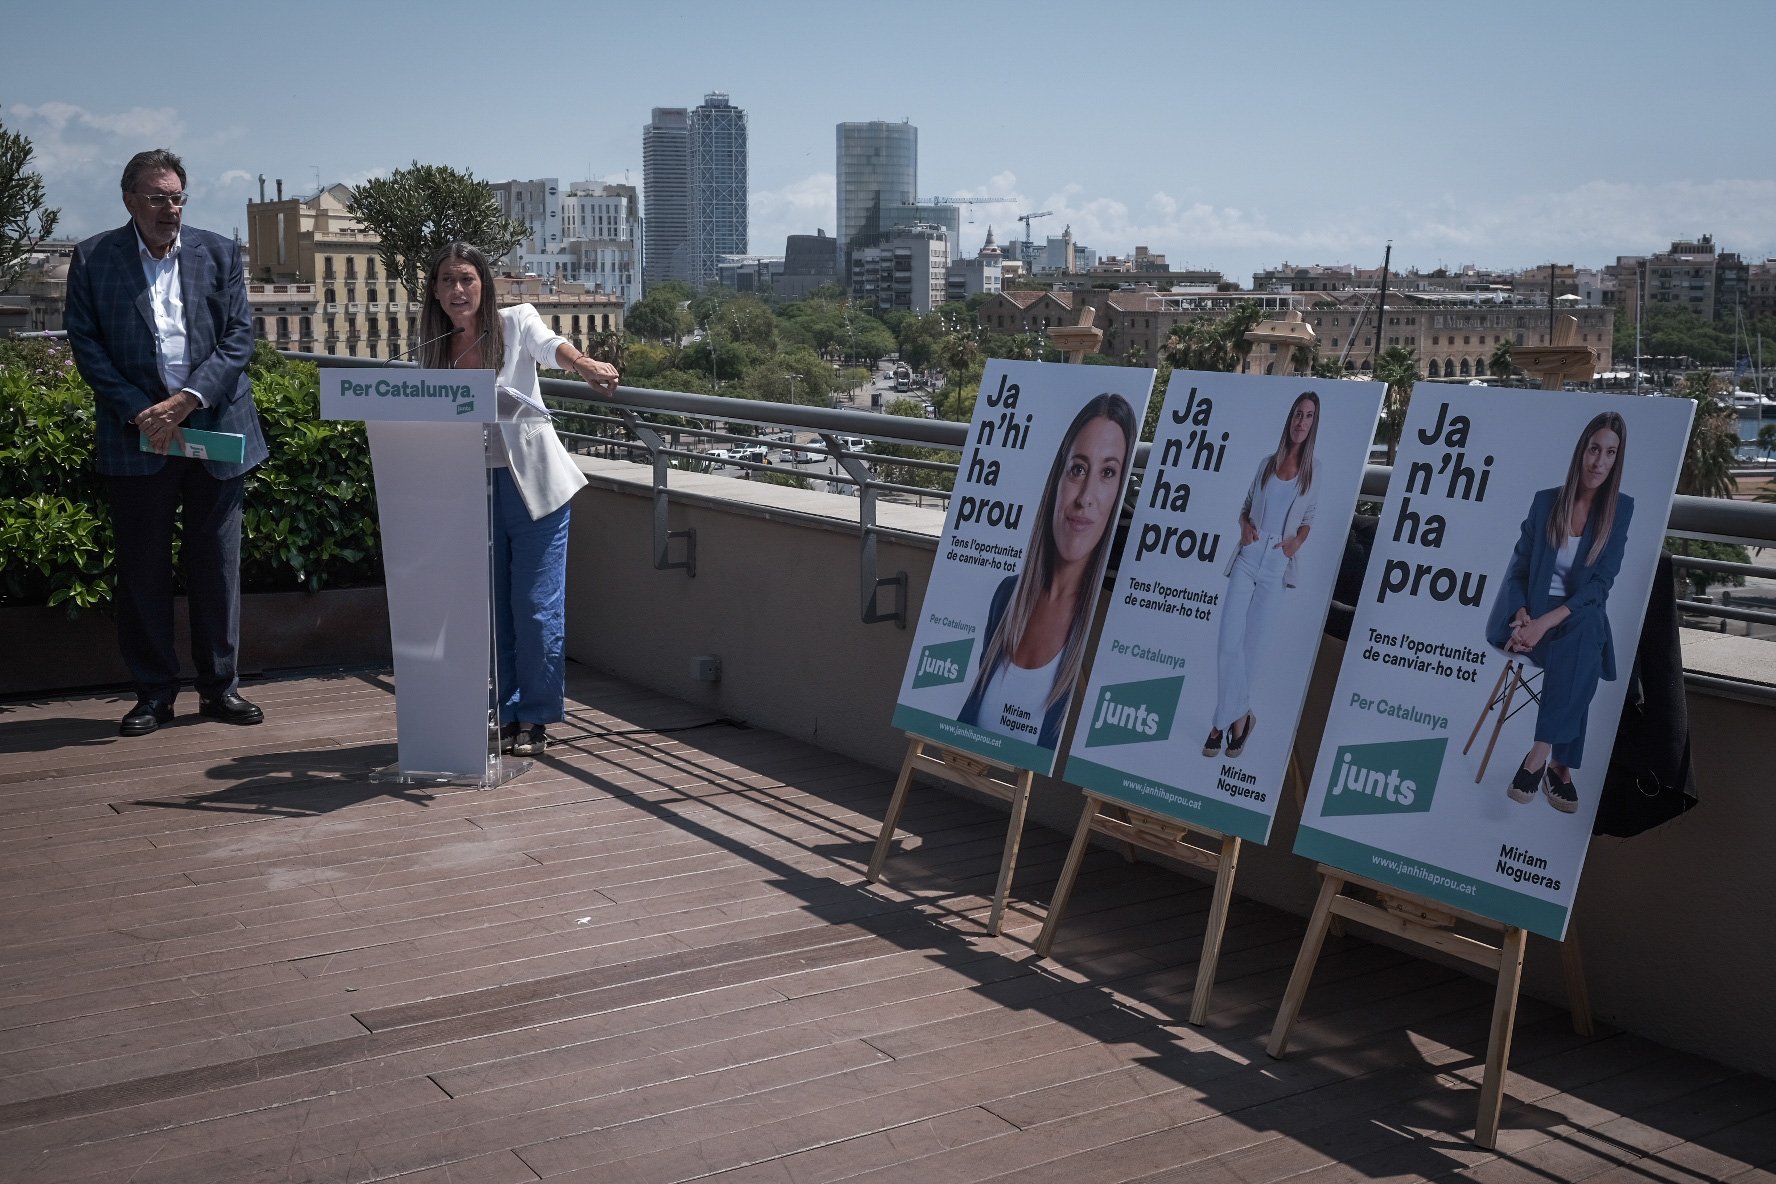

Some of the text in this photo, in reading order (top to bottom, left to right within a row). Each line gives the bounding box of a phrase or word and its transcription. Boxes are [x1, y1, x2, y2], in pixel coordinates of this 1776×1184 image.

[1447, 314, 1480, 328] Museu
[340, 380, 475, 402] Per Catalunya.
[987, 374, 1020, 409] Ja
[1172, 387, 1213, 427] Ja
[1417, 402, 1471, 449] Ja
[967, 448, 1000, 486] ha
[1149, 468, 1191, 512] ha
[954, 495, 1023, 530] prou
[1392, 496, 1447, 549] ha
[951, 535, 970, 549] Tens
[1135, 522, 1221, 563] prou
[946, 550, 1016, 572] de canviar-ho tot
[1129, 577, 1151, 592] Tens
[1376, 558, 1488, 608] prou
[1124, 593, 1211, 621] de canviar-ho tot
[930, 614, 976, 634] Per Catalunya
[1368, 627, 1398, 648] Tens
[918, 650, 959, 680] junts
[1111, 640, 1186, 670] Per Catalunya
[1362, 646, 1478, 683] de canviar-ho tot
[1000, 714, 1038, 735] Nogueras
[1003, 703, 1031, 720] Miriam
[1095, 691, 1159, 736] junts
[1350, 692, 1449, 730] Per Catalunya
[939, 722, 1002, 748] www.janhihaprou.cat
[1220, 764, 1257, 785] Miriam
[1332, 752, 1417, 806] junts
[1122, 778, 1202, 810] www.janhihaprou.cat
[1216, 778, 1267, 803] Nogueras
[1500, 844, 1548, 870] Miriam
[1371, 853, 1477, 896] www.janhihaprou.cat
[1496, 859, 1561, 891] Nogueras
